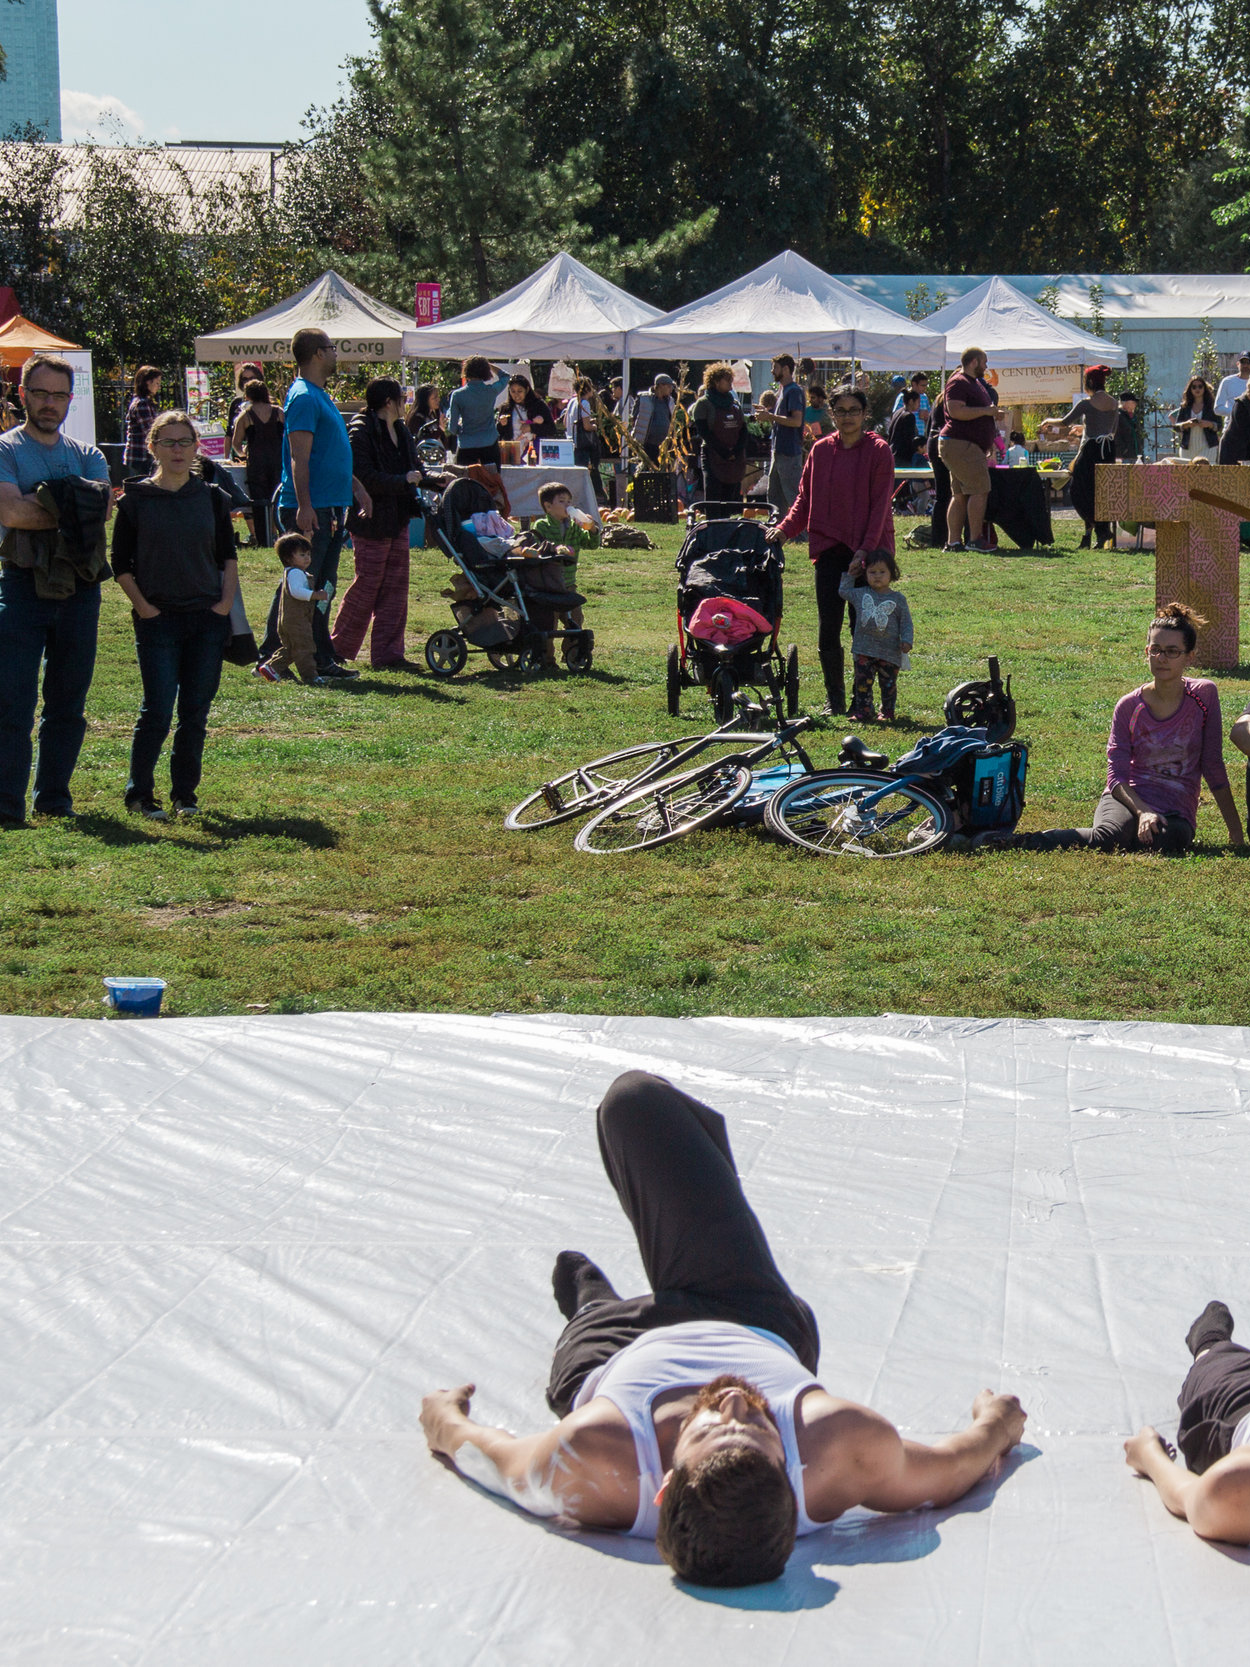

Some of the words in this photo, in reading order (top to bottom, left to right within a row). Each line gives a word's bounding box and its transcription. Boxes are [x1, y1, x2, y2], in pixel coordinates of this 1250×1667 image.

[418, 296, 431, 317] EBT
[1001, 366, 1049, 378] CENTRAL
[1056, 364, 1081, 375] BAKE
[995, 786, 1005, 806] bike
